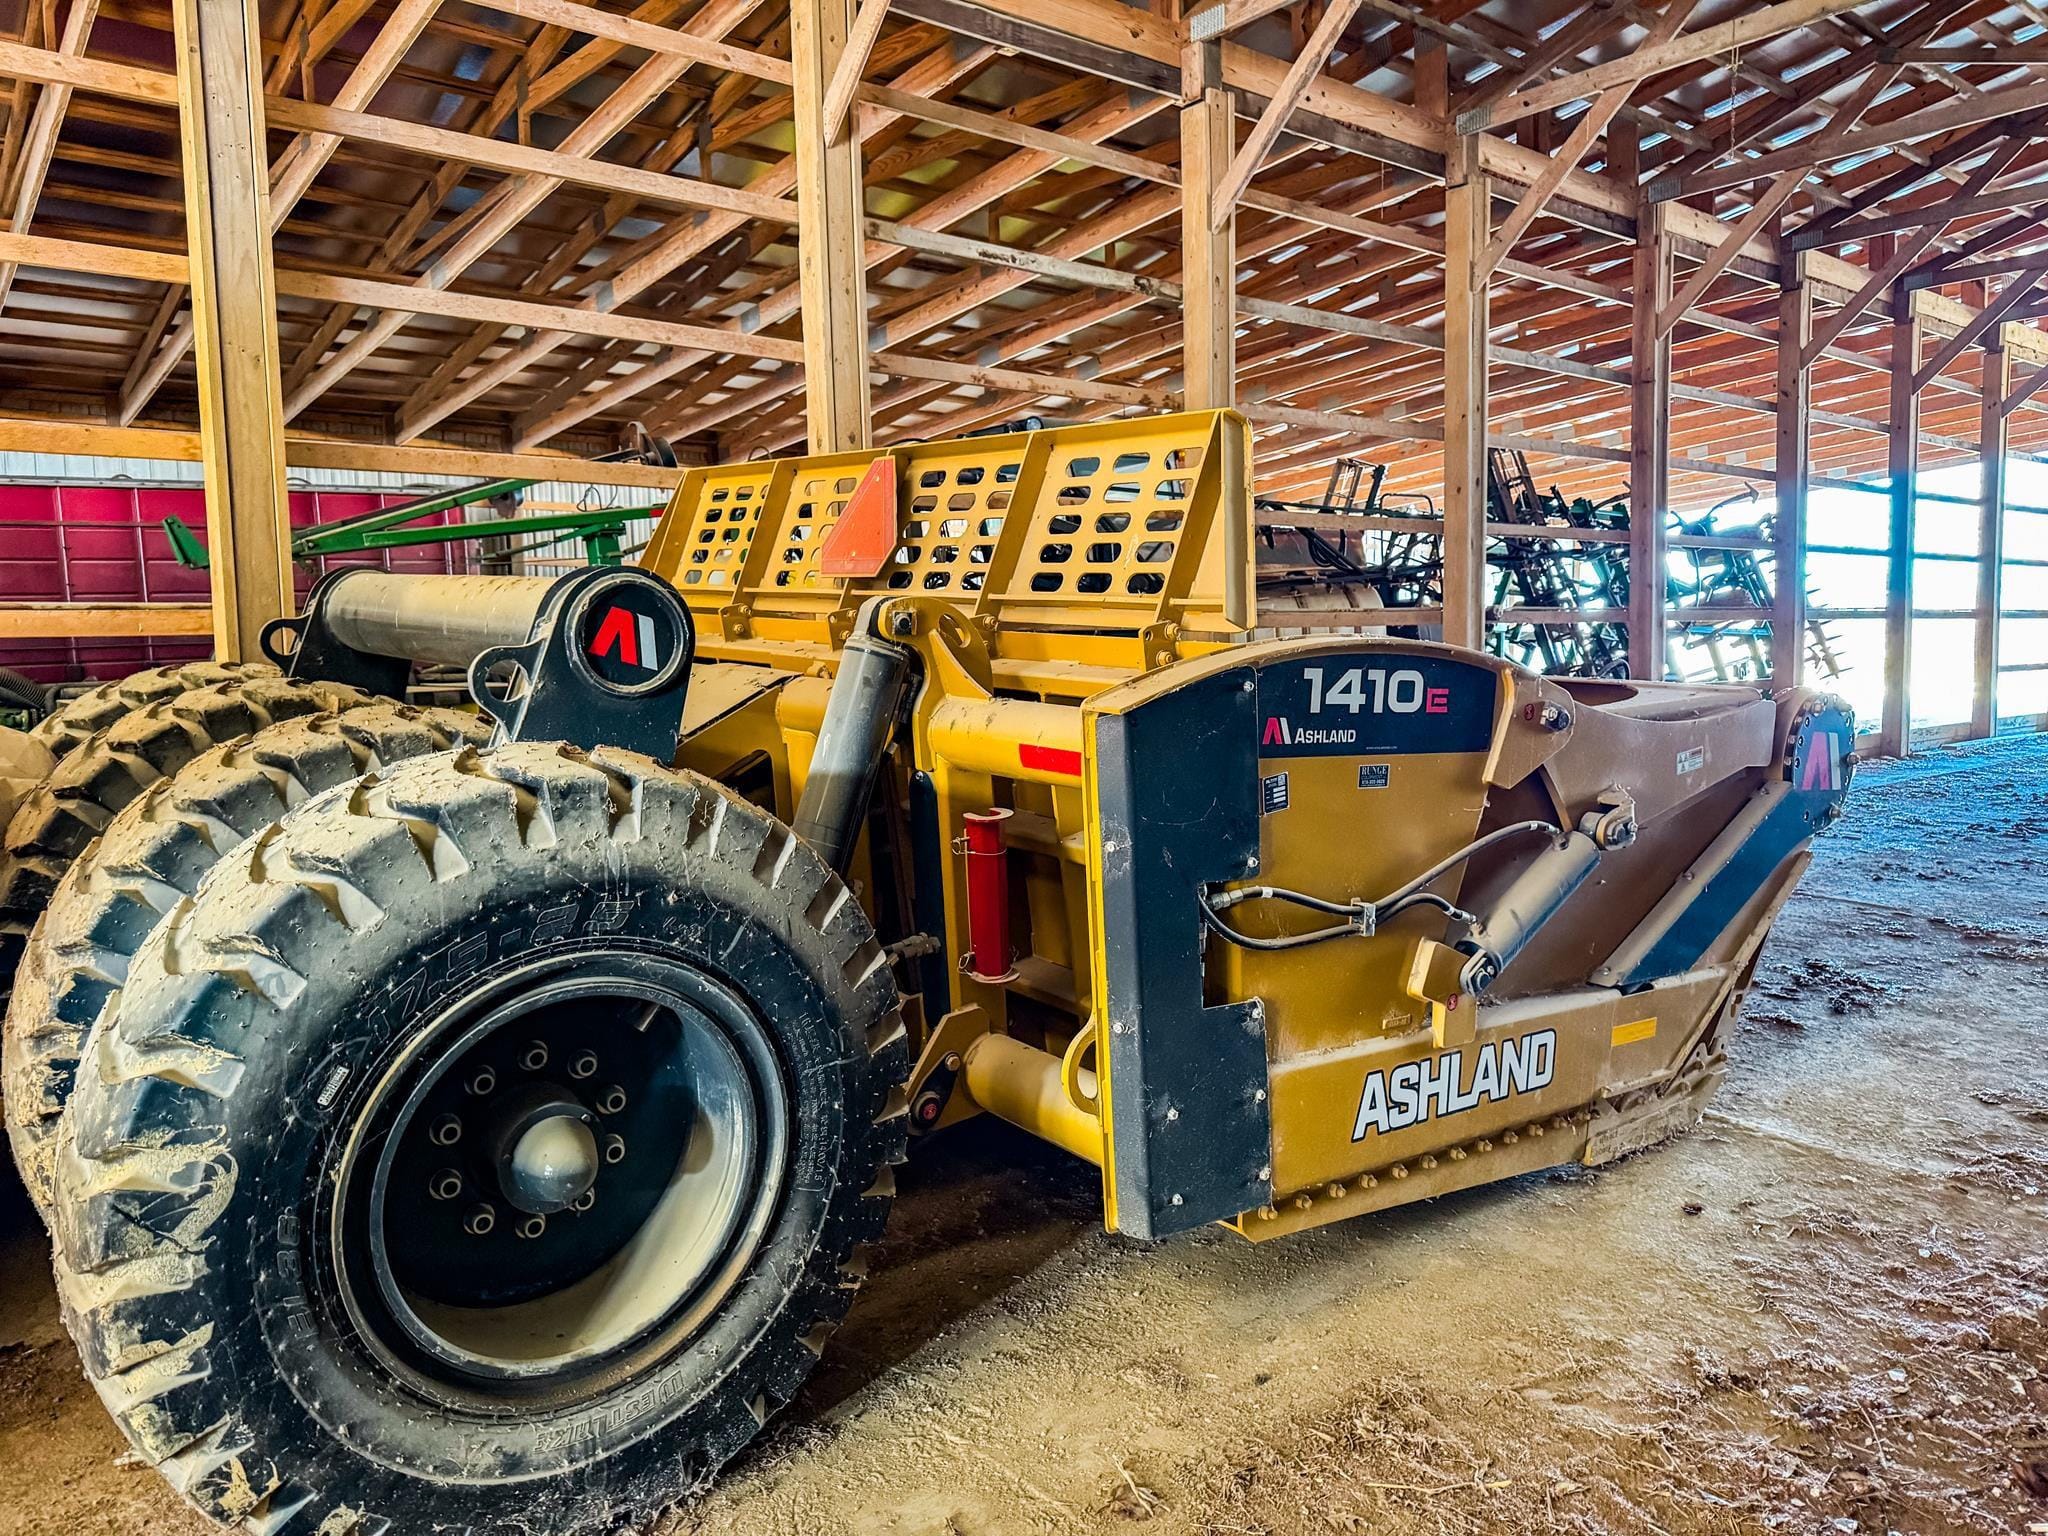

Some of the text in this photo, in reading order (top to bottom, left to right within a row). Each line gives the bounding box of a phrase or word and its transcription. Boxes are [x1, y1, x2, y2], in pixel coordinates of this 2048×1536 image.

[1294, 727, 1357, 744] ASHLAND
[1351, 1028, 1557, 1143] ASHLAND
[534, 1369, 686, 1454] WESTLAKE
